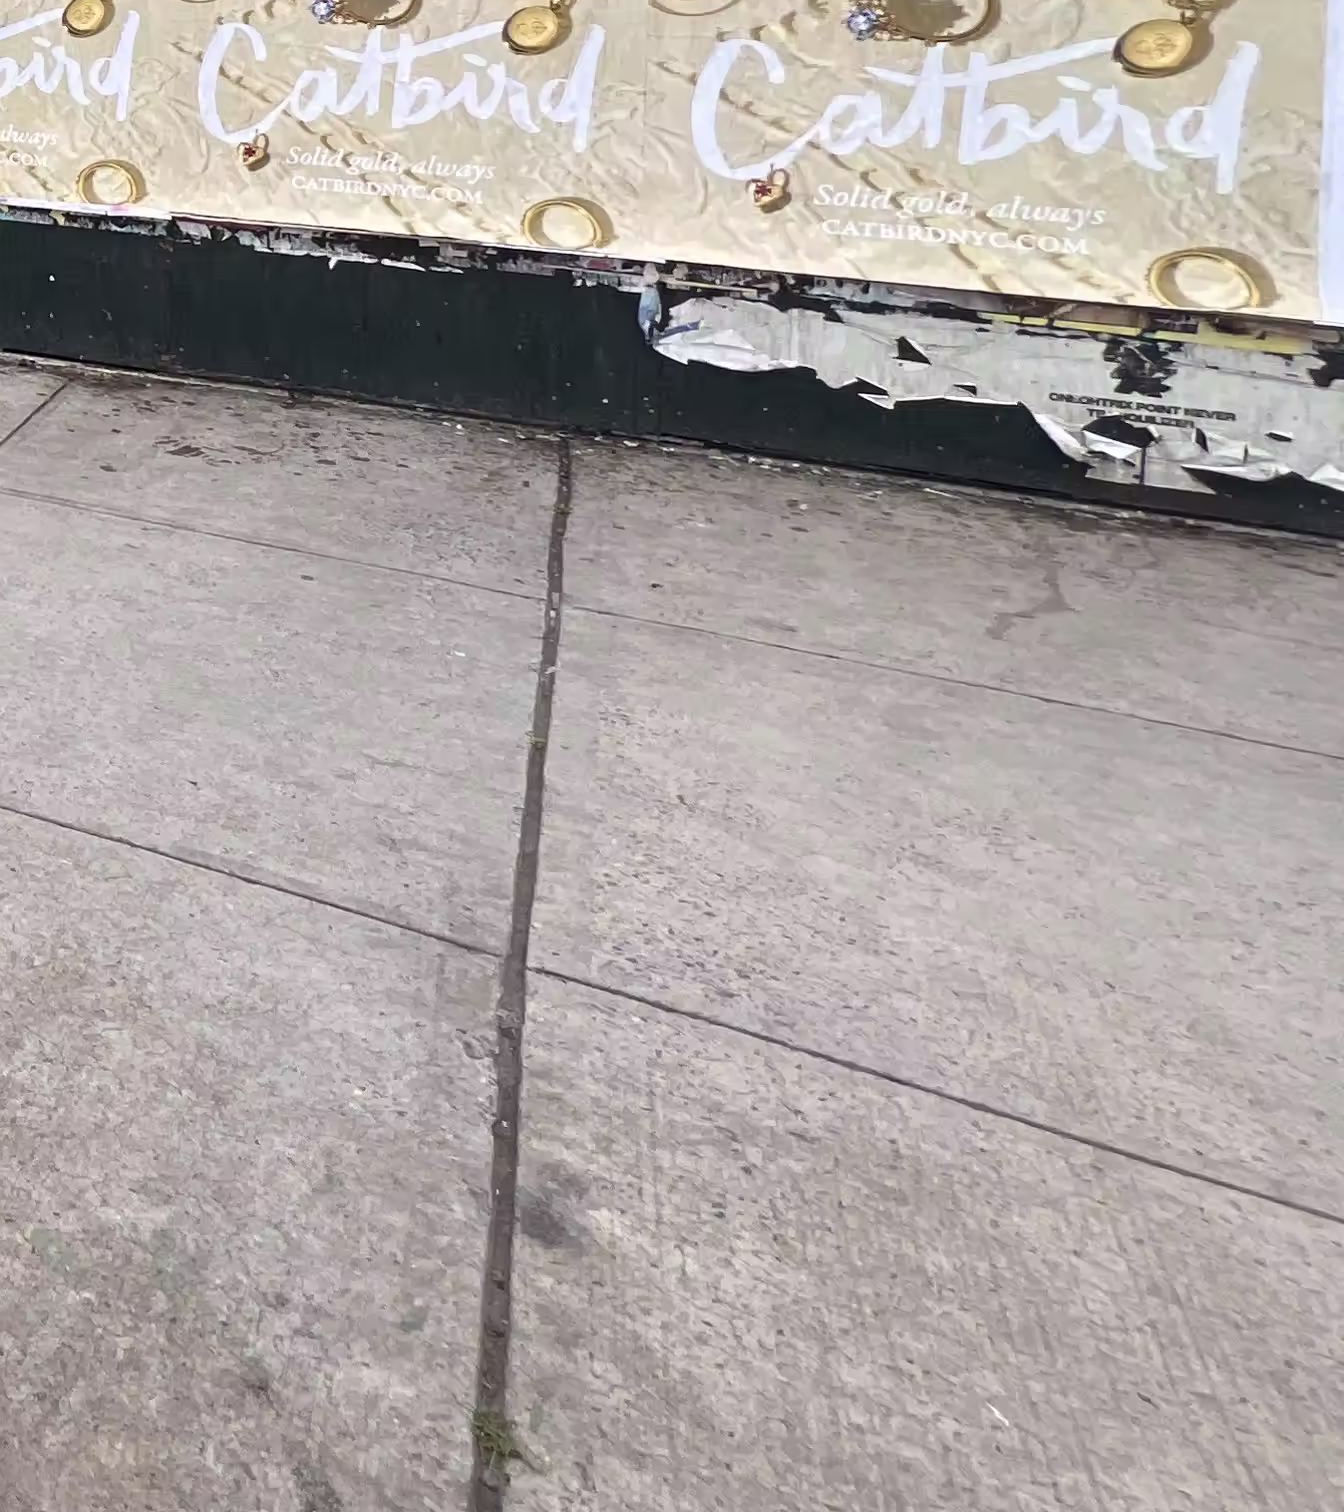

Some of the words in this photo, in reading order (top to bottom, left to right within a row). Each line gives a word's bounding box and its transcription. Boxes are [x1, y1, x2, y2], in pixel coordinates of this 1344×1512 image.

[197, 20, 607, 154] Catbird
[690, 36, 1262, 194] Catbird
[286, 145, 343, 167] Solid
[346, 149, 405, 176] gold,
[410, 154, 496, 185] always
[291, 174, 483, 204] CATBIRDNYC.COM
[813, 184, 892, 211] Solid
[897, 190, 977, 219] gold,
[988, 195, 1107, 231] always
[821, 219, 1090, 255] CATBIRDNYC.COM
[1136, 401, 1181, 415] POINT
[1184, 408, 1236, 422] NEVER
